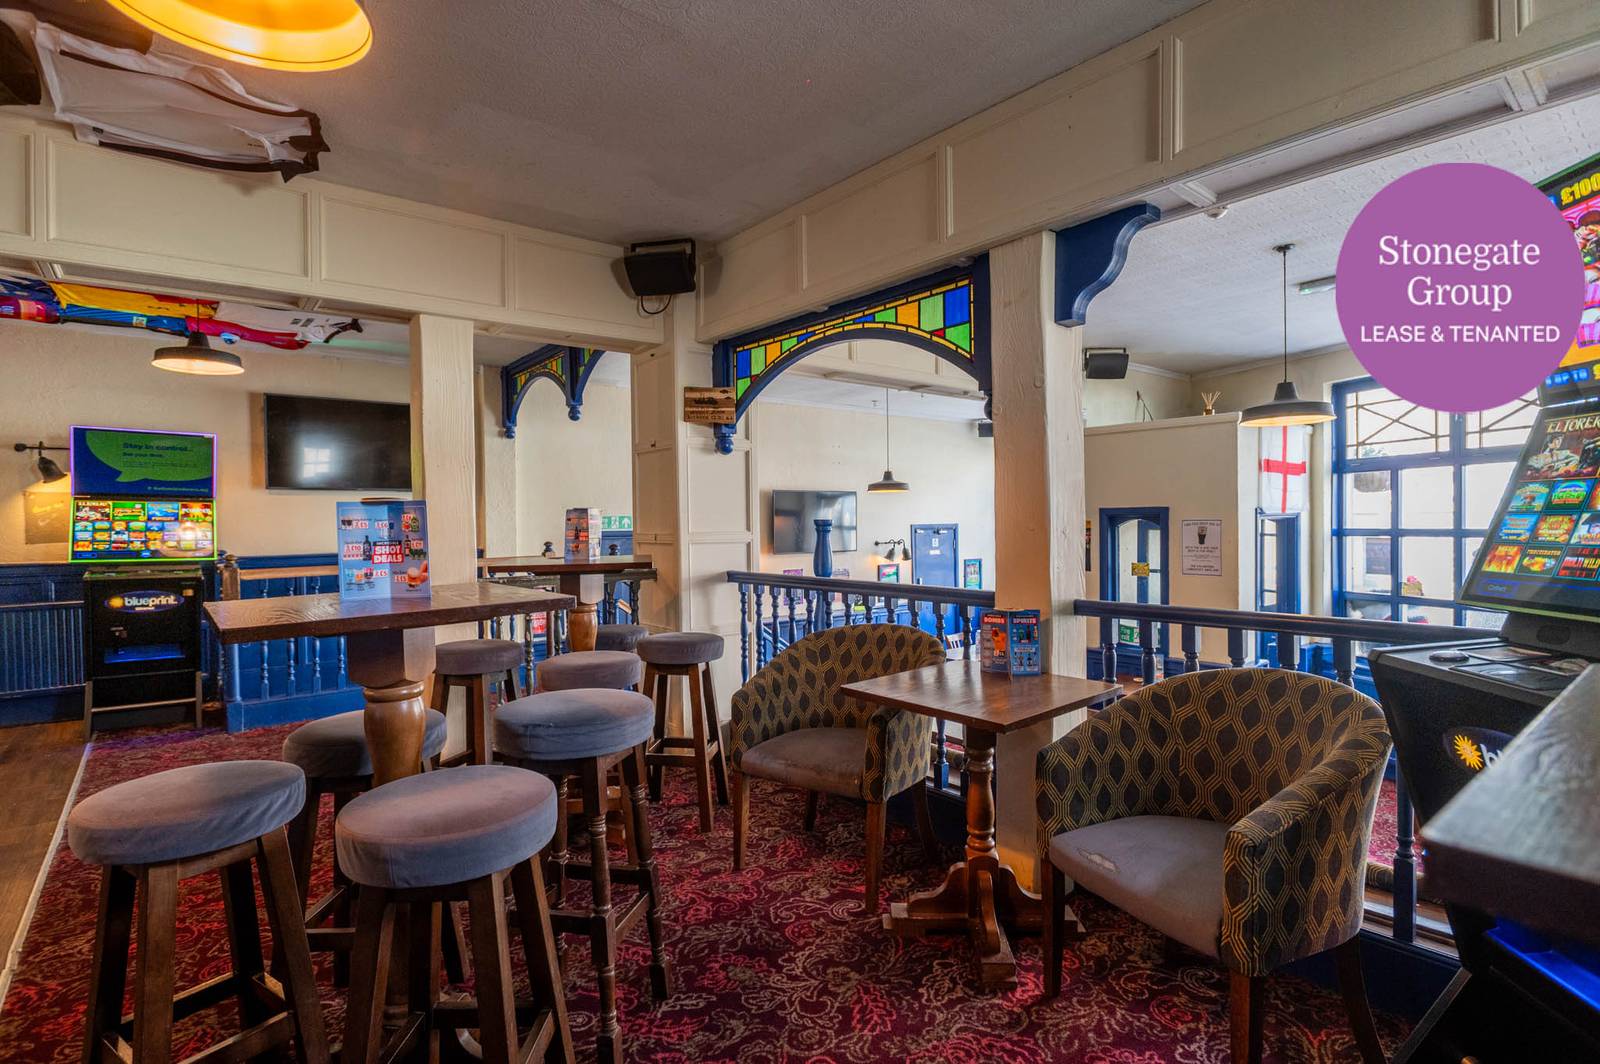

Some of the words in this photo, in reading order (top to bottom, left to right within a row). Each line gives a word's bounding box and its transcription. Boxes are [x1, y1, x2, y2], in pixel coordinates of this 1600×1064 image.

[374, 546, 401, 554] SHOT
[373, 554, 403, 563] DEALS
[124, 595, 178, 608] blueprint
